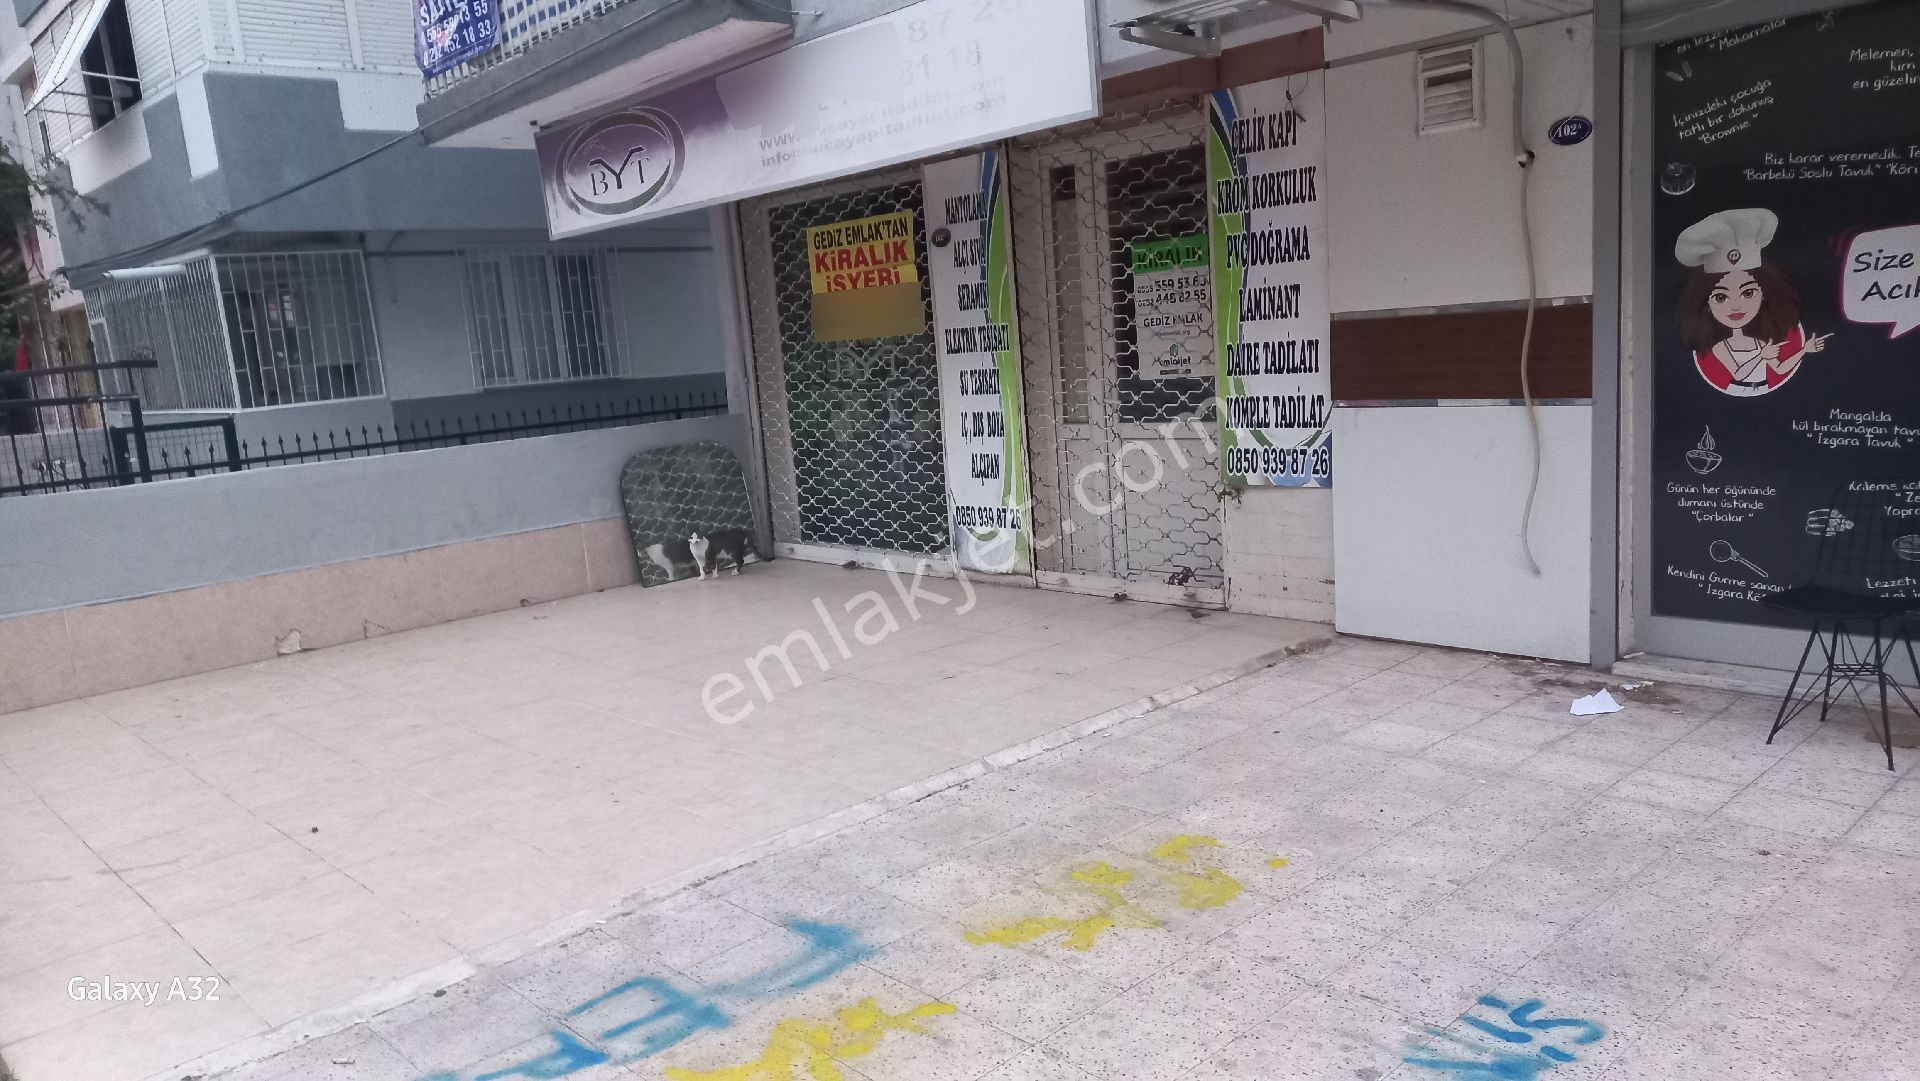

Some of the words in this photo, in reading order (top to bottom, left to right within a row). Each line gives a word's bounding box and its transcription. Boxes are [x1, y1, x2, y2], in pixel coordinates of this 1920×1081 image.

[463, 26, 475, 44] 18
[478, 20, 491, 38] 33
[1231, 108, 1266, 166] ÇELİK
[1269, 110, 1297, 149] KAPI
[1765, 152, 1784, 165] Biz
[1789, 152, 1824, 164] karar
[1799, 166, 1832, 179] Soslu
[1217, 176, 1249, 214] KROM
[1252, 166, 1317, 210] KORKULUK
[845, 217, 908, 245] EMLAK'TAN
[1227, 232, 1248, 269] PVC
[1251, 220, 1311, 266] DOĞRAMA
[1853, 249, 1914, 273] Size
[1239, 278, 1300, 322] LAMİNANT
[1227, 335, 1260, 376] DAİRE
[1263, 331, 1319, 374] TADİLATI
[960, 368, 969, 396] SU
[1226, 396, 1270, 429] KOMPLE
[1273, 386, 1324, 429] TADİLAT
[1830, 408, 1891, 424] Mangalda
[987, 411, 1005, 438] BOYA
[1865, 434, 1901, 448] Tavuk
[972, 452, 999, 486] ALÇIPAN
[1228, 448, 1258, 474] 0850
[1262, 448, 1287, 474] 939
[1291, 448, 1307, 475] 87
[1311, 448, 1329, 476] 26
[1667, 482, 1699, 493] Günün
[1703, 483, 1720, 494] her
[956, 505, 976, 527] 0850
[978, 506, 994, 528] 939
[996, 507, 1007, 529] 87
[1010, 507, 1022, 530] 26
[1667, 564, 1705, 580] Kendini
